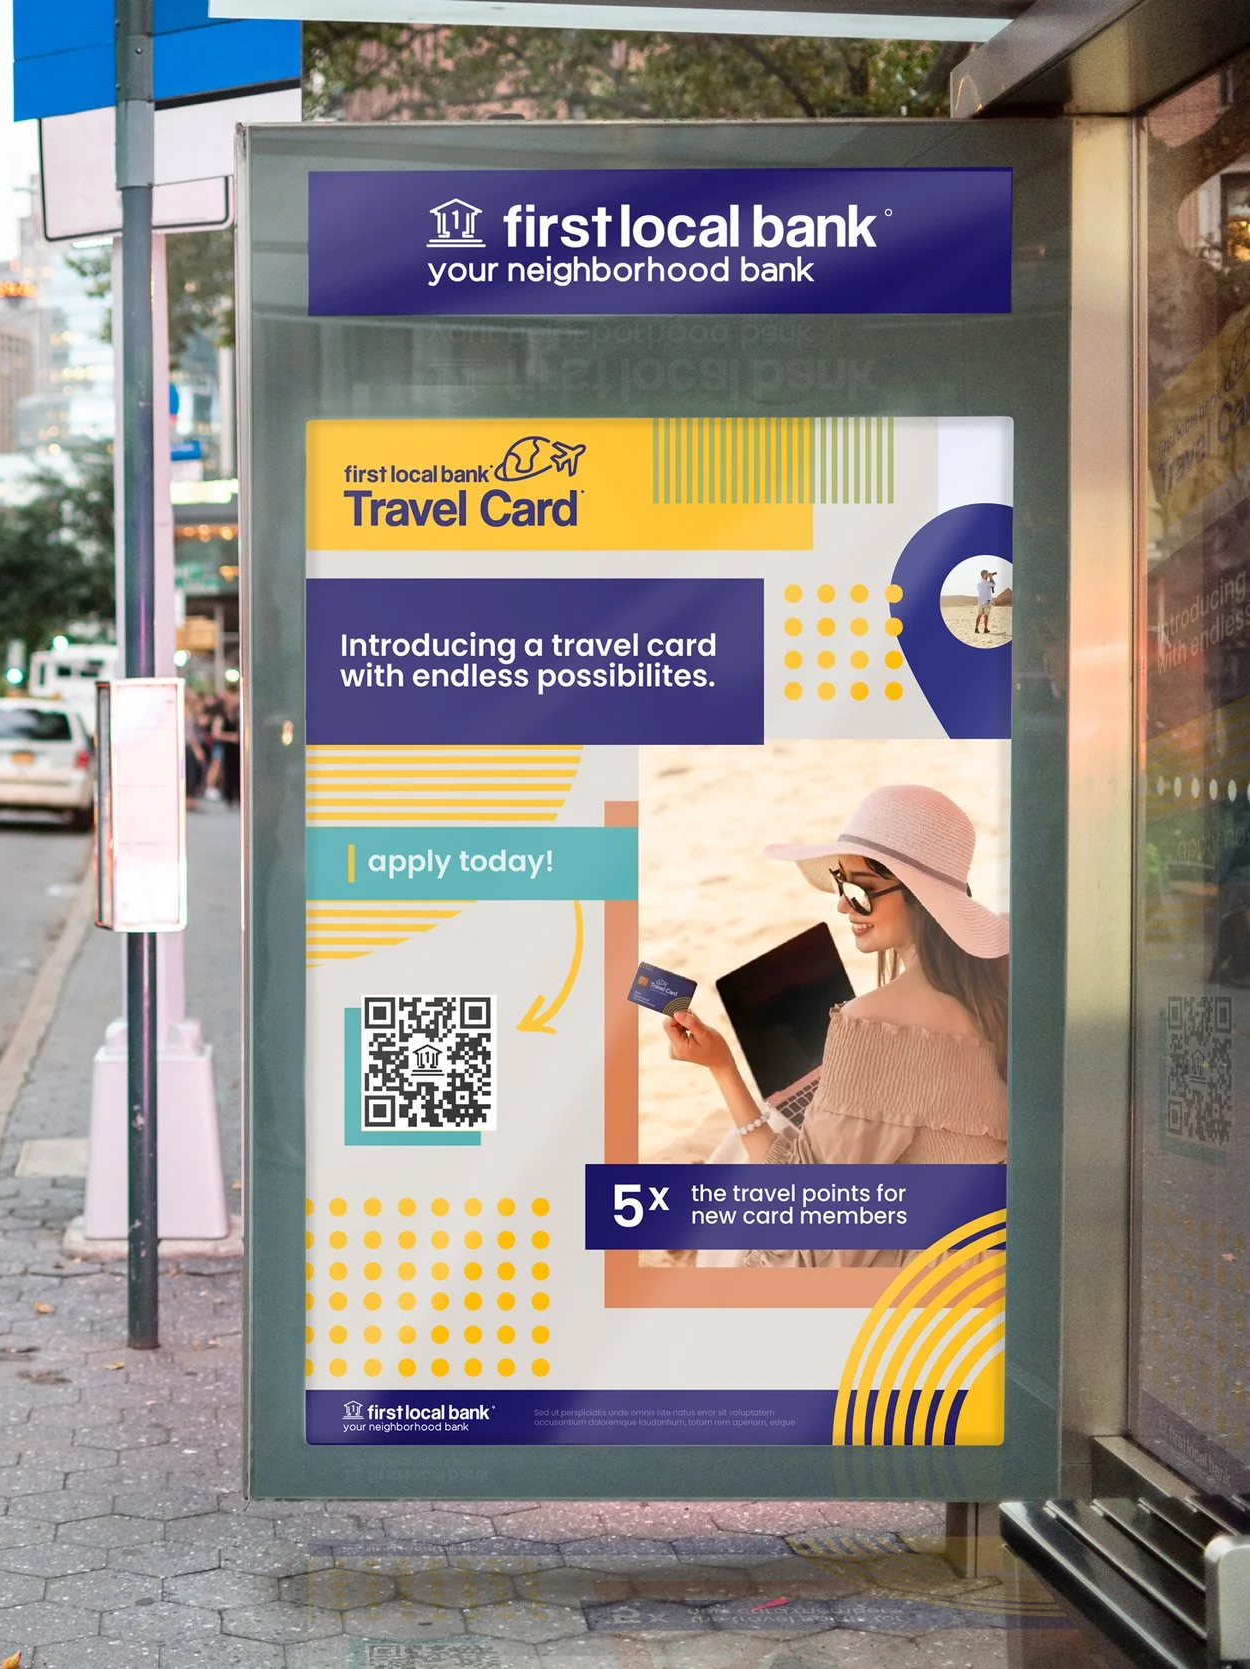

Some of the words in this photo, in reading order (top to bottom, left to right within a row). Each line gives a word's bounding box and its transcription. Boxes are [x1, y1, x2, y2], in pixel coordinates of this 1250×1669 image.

[503, 204, 612, 248] first
[620, 204, 739, 248] local
[753, 204, 878, 248] bank
[427, 263, 498, 286] your
[508, 256, 730, 286] neighborhood
[740, 256, 815, 283] bank
[344, 465, 387, 483] first
[391, 465, 437, 483] local
[442, 465, 489, 483] bank
[343, 490, 466, 527] Travel
[480, 489, 578, 527] Card
[341, 632, 516, 664] Introducing
[524, 639, 543, 657] a
[551, 633, 639, 657] travel
[647, 633, 716, 657] card
[340, 662, 404, 687] with
[412, 664, 529, 687] endless
[538, 662, 715, 695] possibilites.
[368, 849, 451, 879] apply
[458, 849, 553, 879] today!
[692, 1184, 726, 1202] the
[733, 1184, 796, 1202] travel
[803, 1184, 871, 1207] points
[877, 1184, 906, 1202] for
[692, 1210, 737, 1225] new
[743, 1207, 794, 1225] card
[800, 1207, 908, 1225] members
[367, 1404, 404, 1420] first
[405, 1404, 445, 1420] local
[448, 1404, 490, 1420] bank
[533, 1408, 549, 1417] Sed
[551, 1408, 559, 1417] ut
[630, 1408, 655, 1417] omnis
[697, 1409, 716, 1417] error
[717, 1408, 727, 1417] sit
[728, 1408, 775, 1419] voluptatem
[533, 1418, 587, 1427] accusantium
[688, 1418, 713, 1427] totam
[342, 1423, 367, 1433] your
[368, 1421, 442, 1433] neighborhood
[444, 1421, 470, 1432] bank
